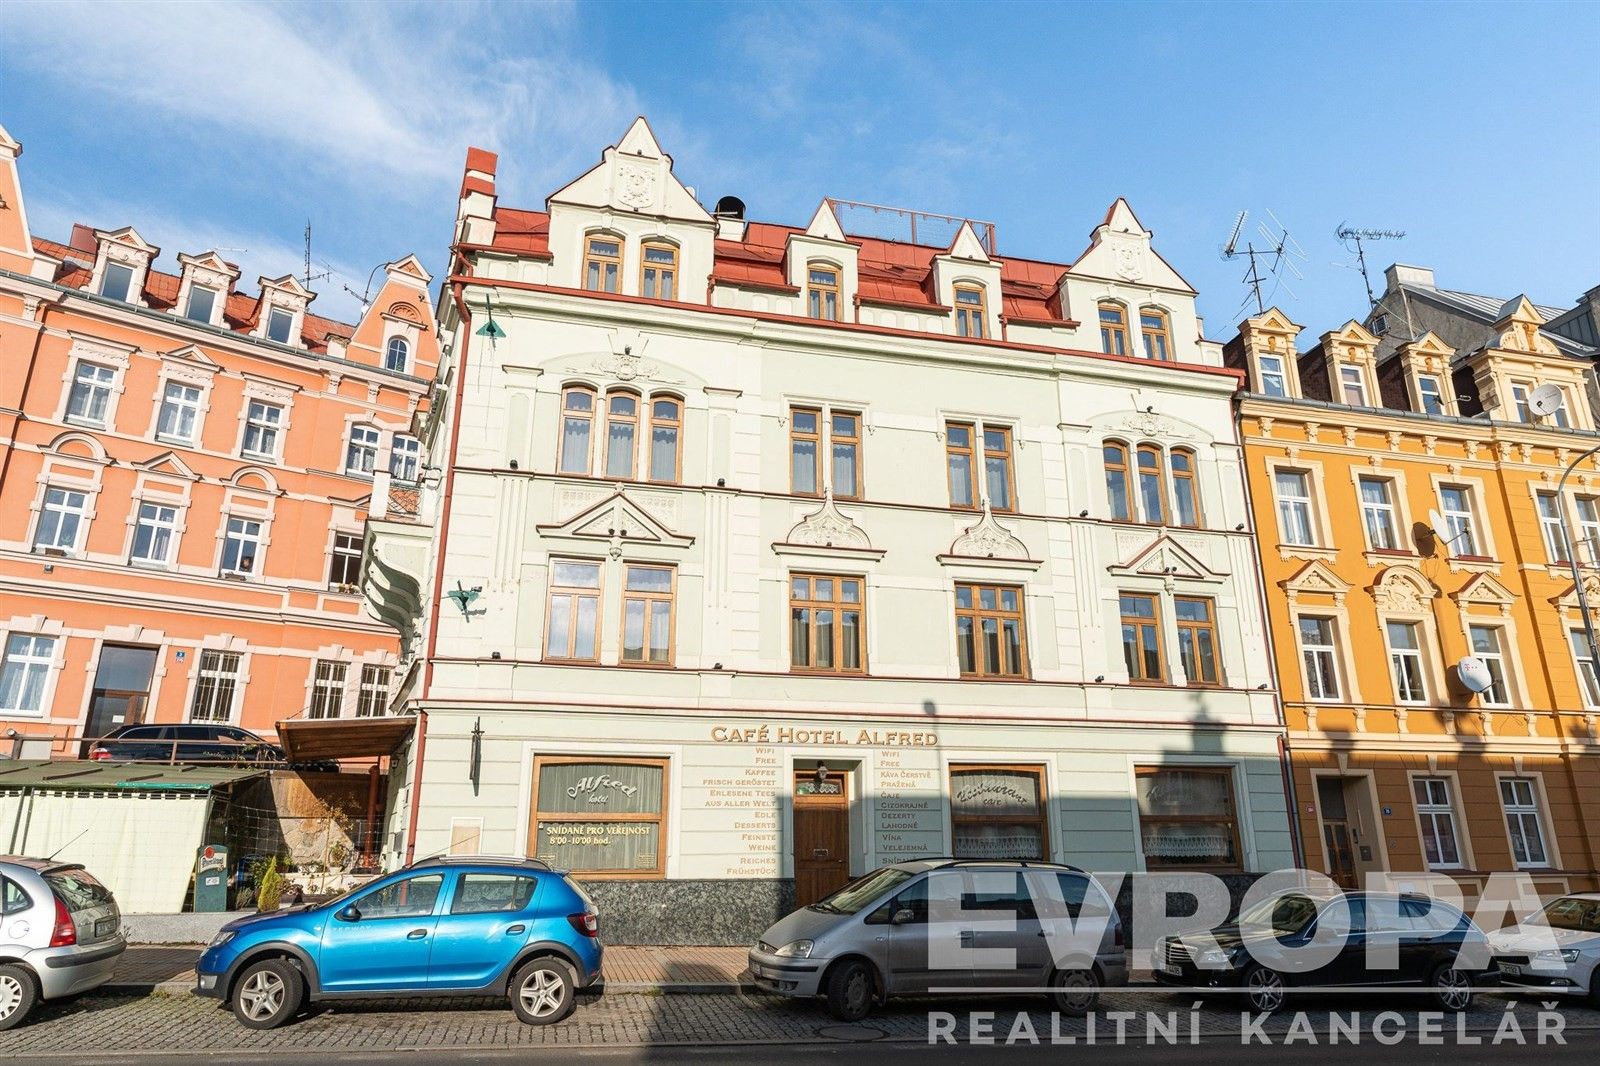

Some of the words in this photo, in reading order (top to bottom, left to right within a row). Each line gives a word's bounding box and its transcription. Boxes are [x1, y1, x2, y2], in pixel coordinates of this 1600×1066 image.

[710, 724, 770, 743] CAFÉ
[777, 727, 848, 745] HOTEL
[856, 729, 938, 746] ALFRED
[735, 778, 776, 786] GERÖSTET
[567, 774, 638, 799] Alfred
[709, 789, 753, 797] ERLESENE
[881, 801, 929, 809] CIZOKRAJNÉ
[881, 820, 918, 829] LAHODNÉ
[586, 826, 604, 835] PRO
[742, 833, 776, 841] FEINSTE
[882, 833, 902, 841] VÍNA
[882, 843, 928, 851] VELEJEMNÁ
[726, 867, 776, 875] FRÜHSTÜCK
